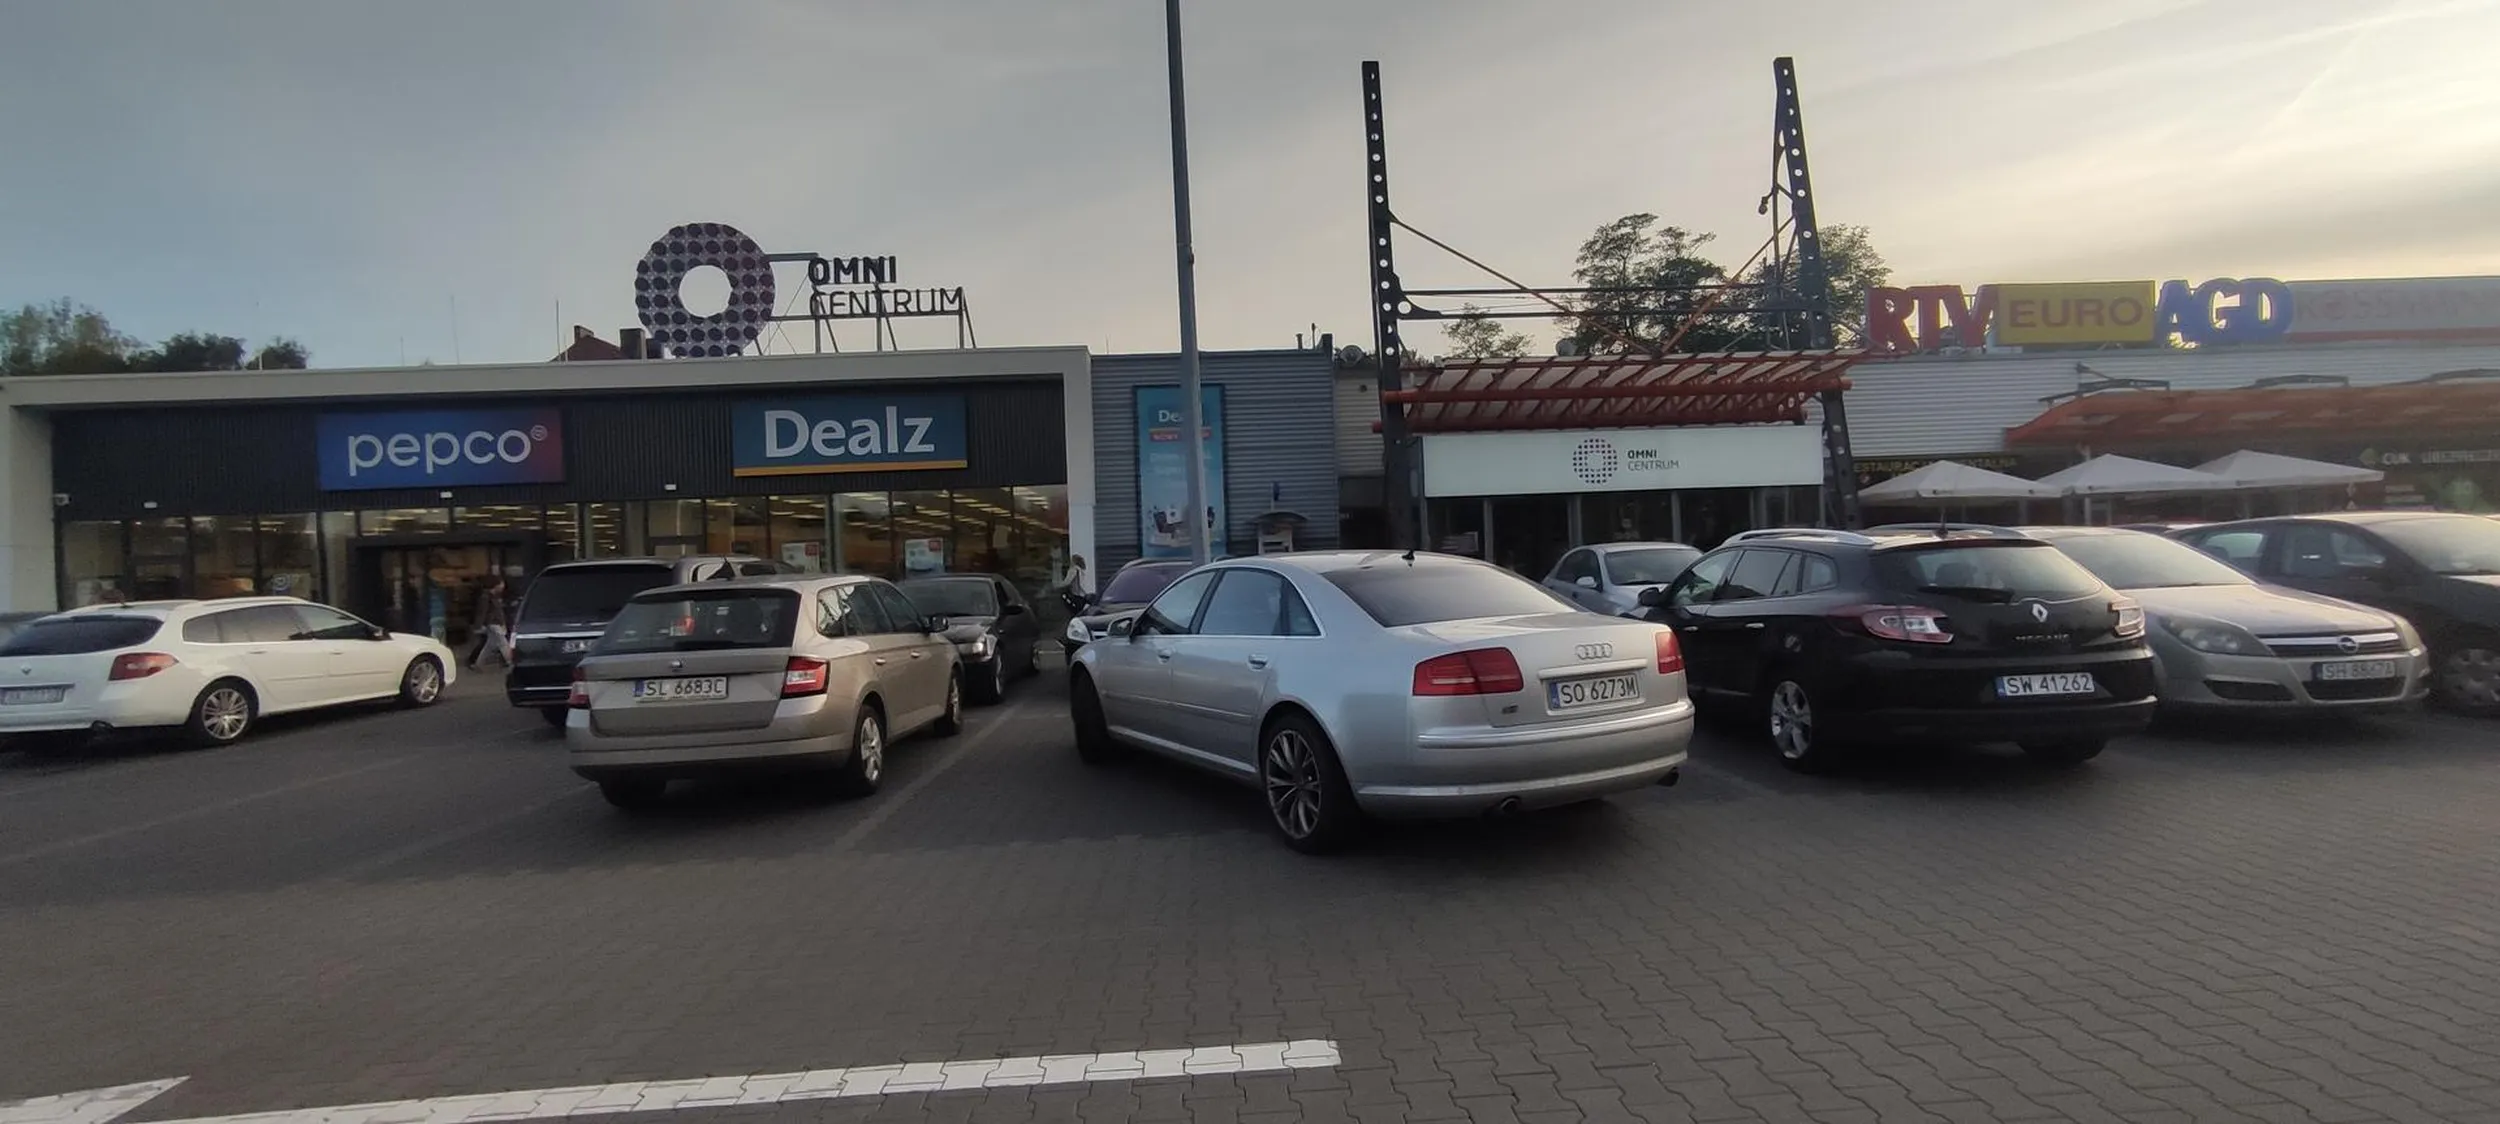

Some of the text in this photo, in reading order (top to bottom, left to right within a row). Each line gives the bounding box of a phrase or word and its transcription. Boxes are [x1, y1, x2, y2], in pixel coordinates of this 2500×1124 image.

[808, 256, 896, 285] OMNI
[810, 288, 964, 316] CENTRUM
[1866, 278, 2294, 350] RTV EURO AGD
[764, 406, 935, 458] Dealz
[348, 430, 531, 476] pepco
[1627, 449, 1657, 459] OMNI
[1627, 460, 1680, 471] CENTRUM
[645, 678, 725, 696] SL 6683C
[1561, 677, 1636, 704] SO 6273M
[2007, 674, 2093, 694] SW 41262
